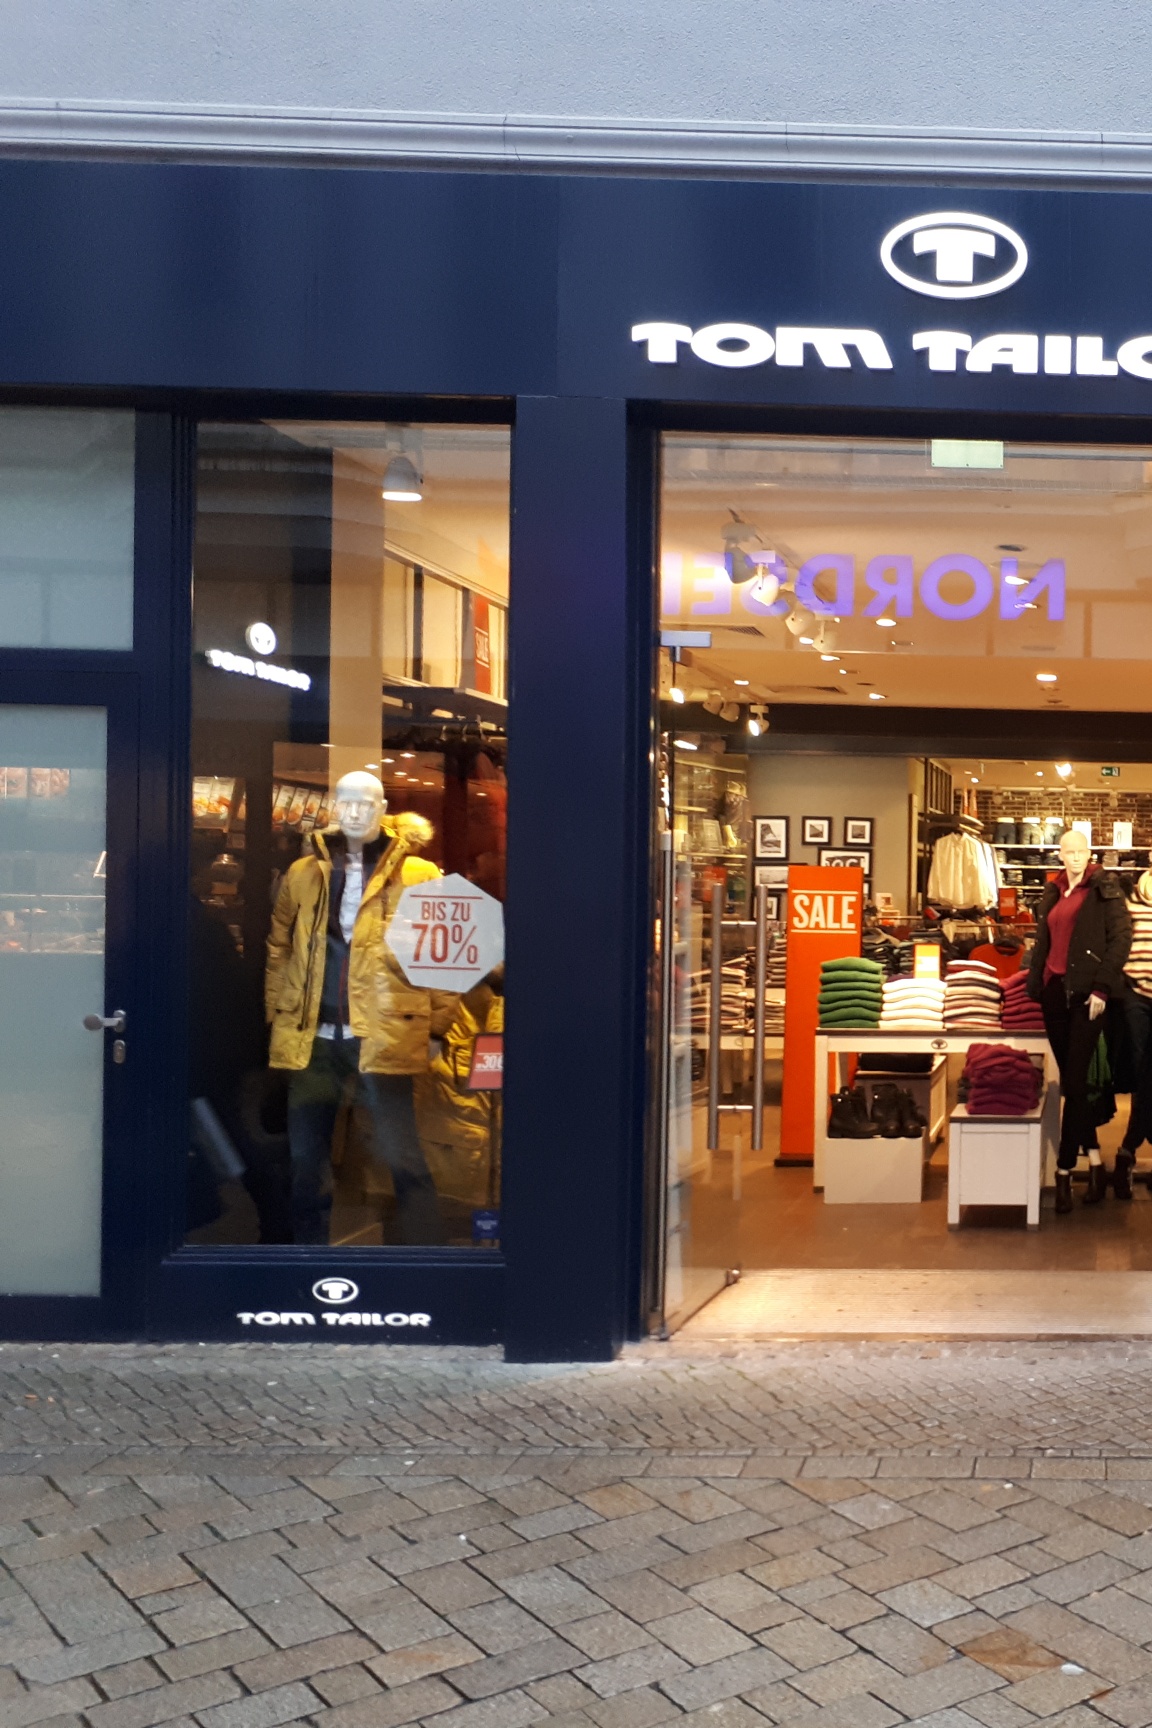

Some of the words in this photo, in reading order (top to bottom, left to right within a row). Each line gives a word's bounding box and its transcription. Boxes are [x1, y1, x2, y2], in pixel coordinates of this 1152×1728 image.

[631, 321, 894, 370] TOM
[421, 901, 447, 921] BIS
[450, 901, 471, 922] ZU
[792, 894, 857, 930] SALE
[411, 923, 479, 965] 70%
[237, 1311, 316, 1326] TOM
[321, 1312, 432, 1327] TAILOR
